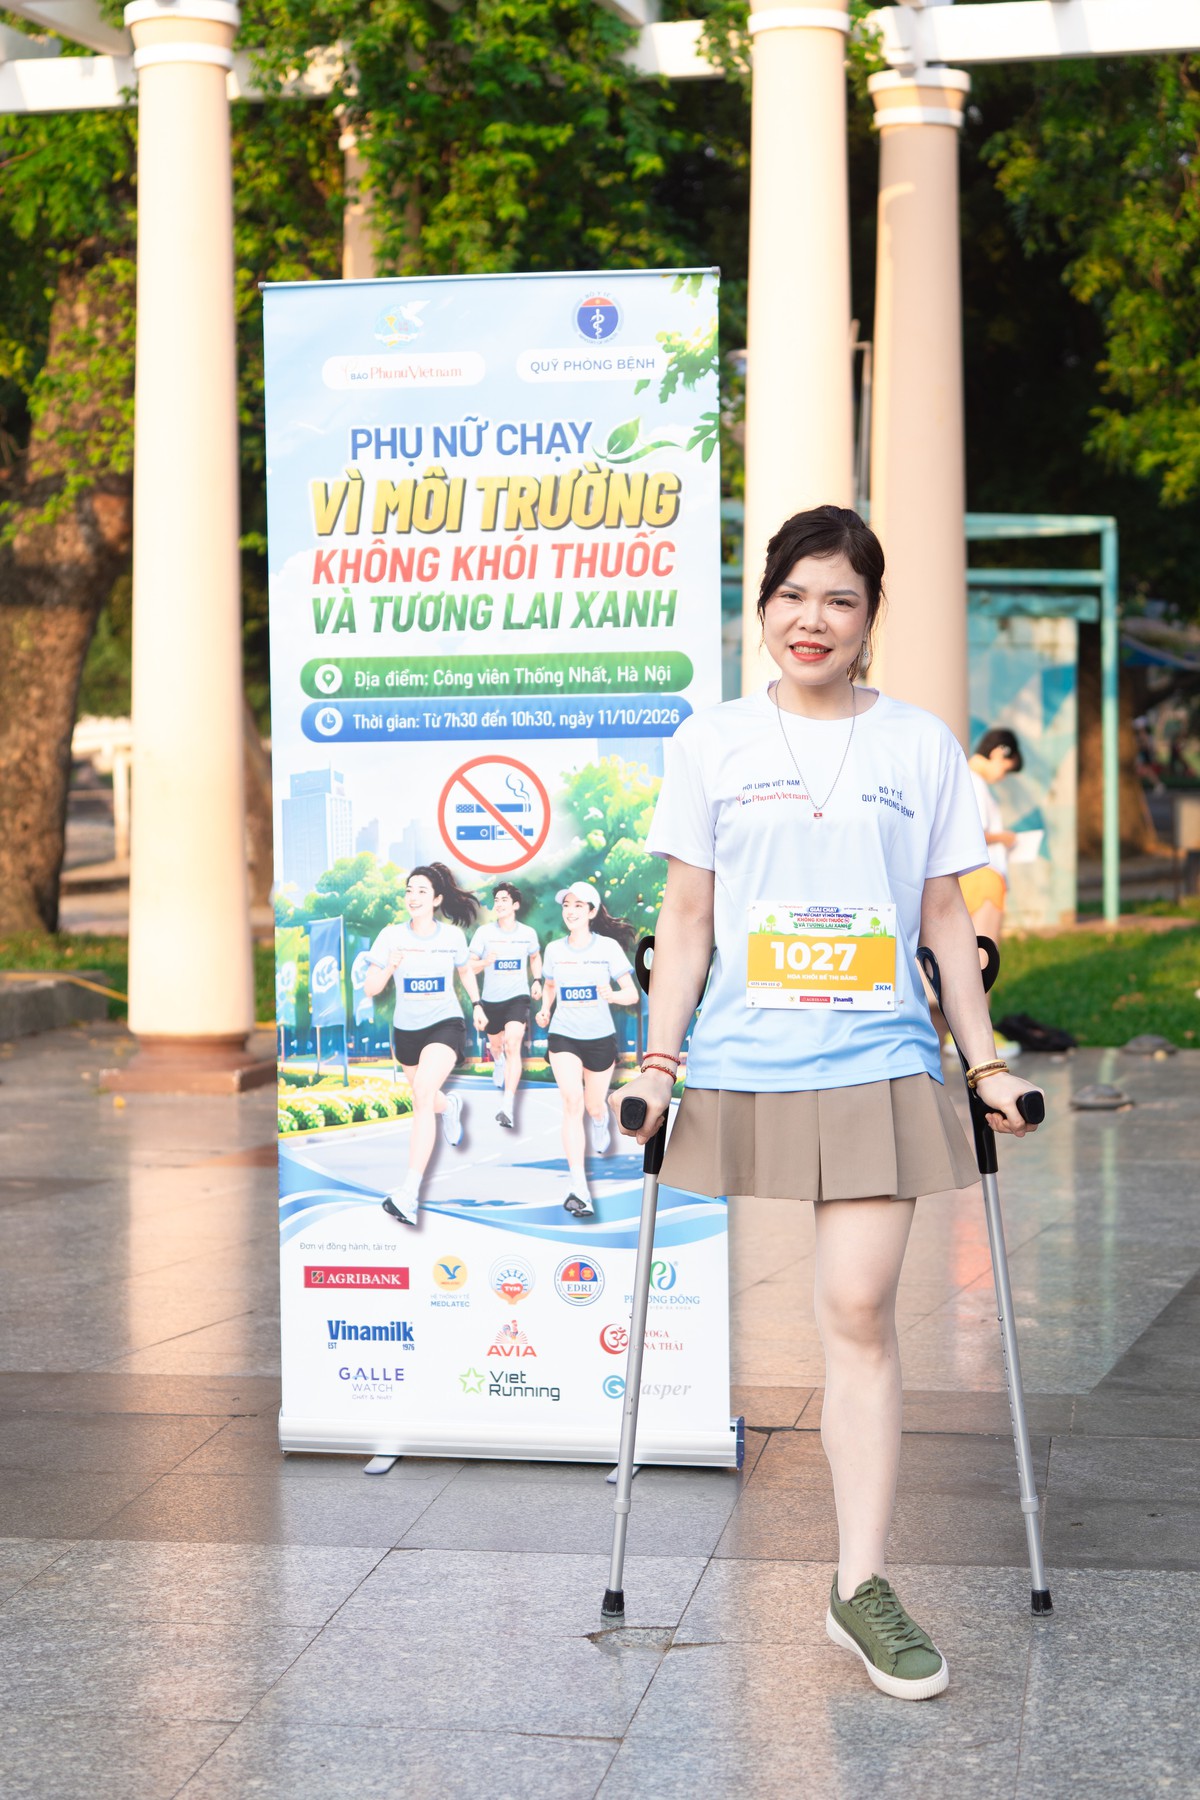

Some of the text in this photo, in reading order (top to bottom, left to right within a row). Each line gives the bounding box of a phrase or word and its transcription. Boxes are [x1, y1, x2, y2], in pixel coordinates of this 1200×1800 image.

[530, 356, 655, 374] QUỸ PHÒNG BỆNH
[350, 416, 593, 466] PHỤ NỮ CHẠY
[311, 462, 682, 536] VÌ MÔI TRƯỜNG
[312, 530, 677, 584] KHÔNG KHÓI THUỐC
[311, 587, 679, 634] VÀ TƯƠNG LAI XANH
[354, 665, 671, 690] Địa điểm: Công viên Thống Nhất, Hà Nội
[353, 708, 680, 732] Thời gian: Từ 7h30 đến 10h30, ngày 11/10/2026
[890, 788, 896, 796] Y
[770, 941, 858, 972] 1027
[498, 960, 518, 969] 0802
[410, 980, 439, 992] 0801
[566, 988, 592, 1000] 0803
[326, 1273, 402, 1285] AGRIBANK
[567, 1284, 592, 1292] EDRI
[670, 1293, 700, 1304] ĐÔNG
[326, 1320, 415, 1342] Vinamilk
[644, 1330, 670, 1338] YOGA
[328, 1342, 337, 1350] EST
[486, 1344, 538, 1358] AVIA
[338, 1366, 404, 1382] GALLE
[489, 1370, 527, 1384] Viet
[352, 1383, 392, 1392] WATCH
[489, 1384, 561, 1402] Running
[641, 1383, 692, 1400] asper
